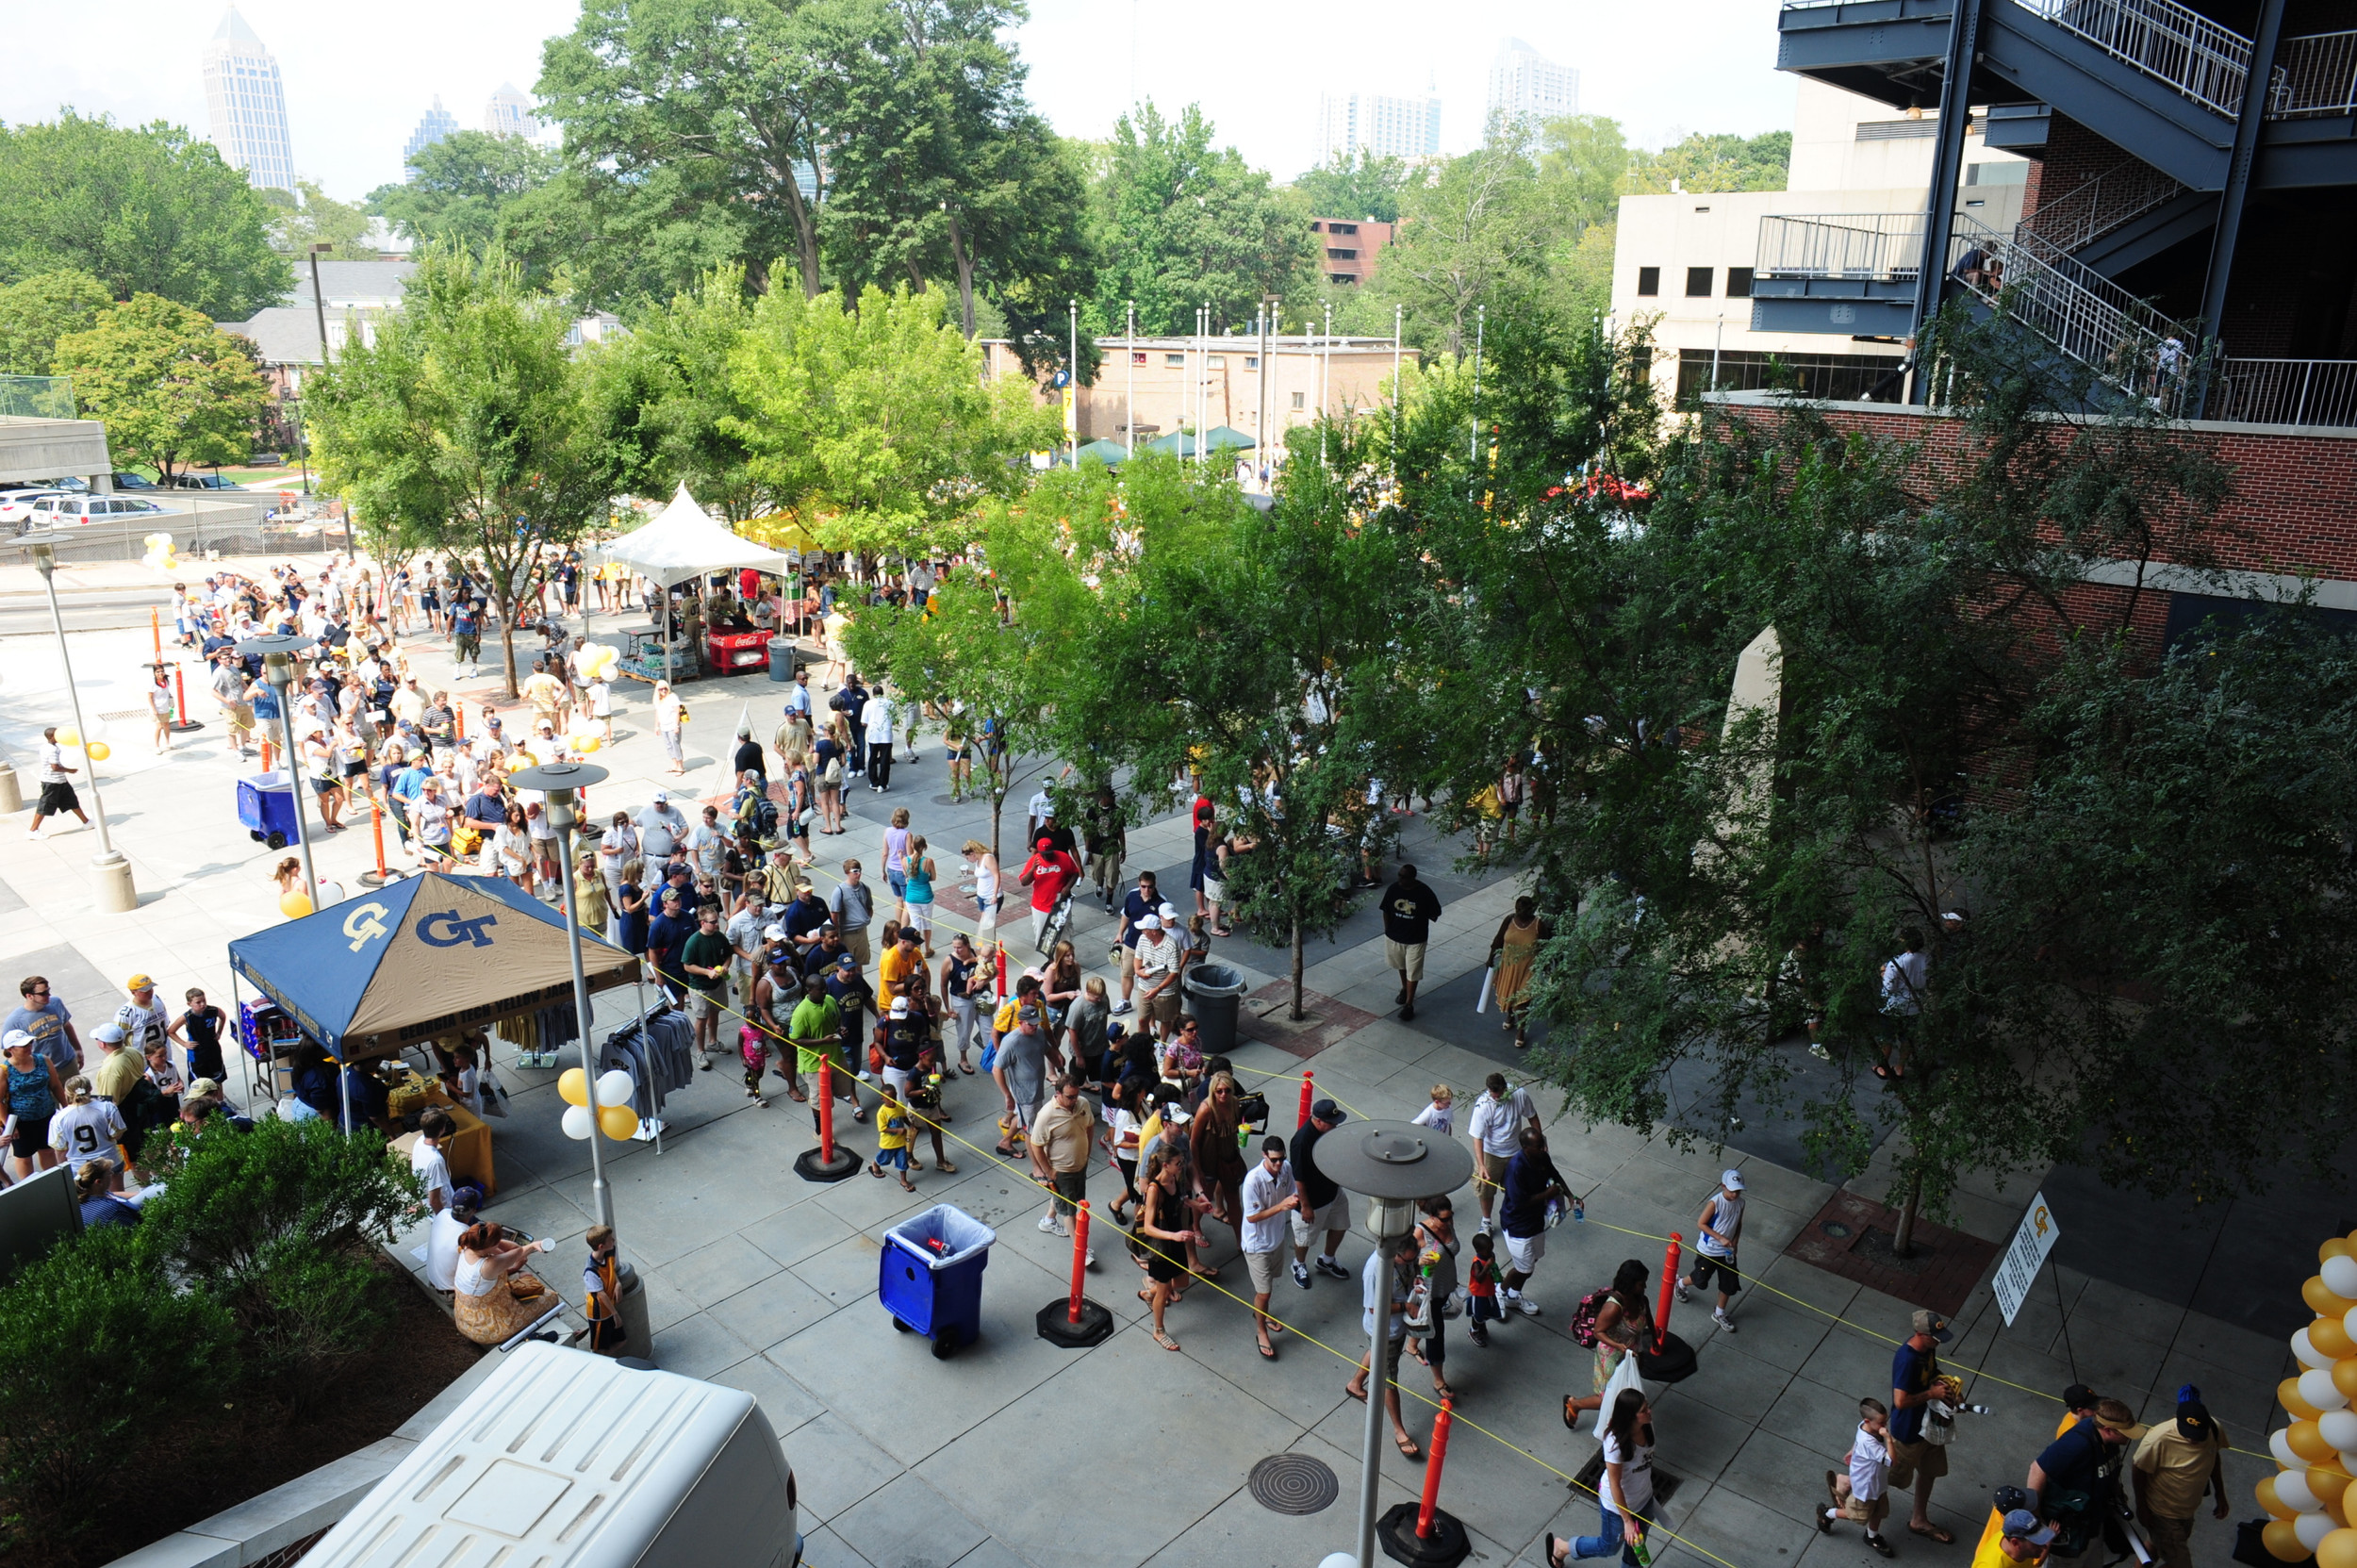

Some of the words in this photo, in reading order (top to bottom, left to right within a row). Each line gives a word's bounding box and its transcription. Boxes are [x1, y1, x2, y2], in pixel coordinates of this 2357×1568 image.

[1057, 372, 1065, 385] P
[1066, 397, 1071, 406] 7
[342, 901, 389, 953] GT
[416, 909, 498, 949] GT
[400, 1011, 457, 1042] GEORGIA
[459, 1005, 492, 1023] TECH
[496, 989, 540, 1014] YELLOW
[544, 974, 595, 999] JACKS
[144, 1019, 168, 1045] 21
[74, 1125, 98, 1153] 9
[2035, 1205, 2049, 1239] GT
